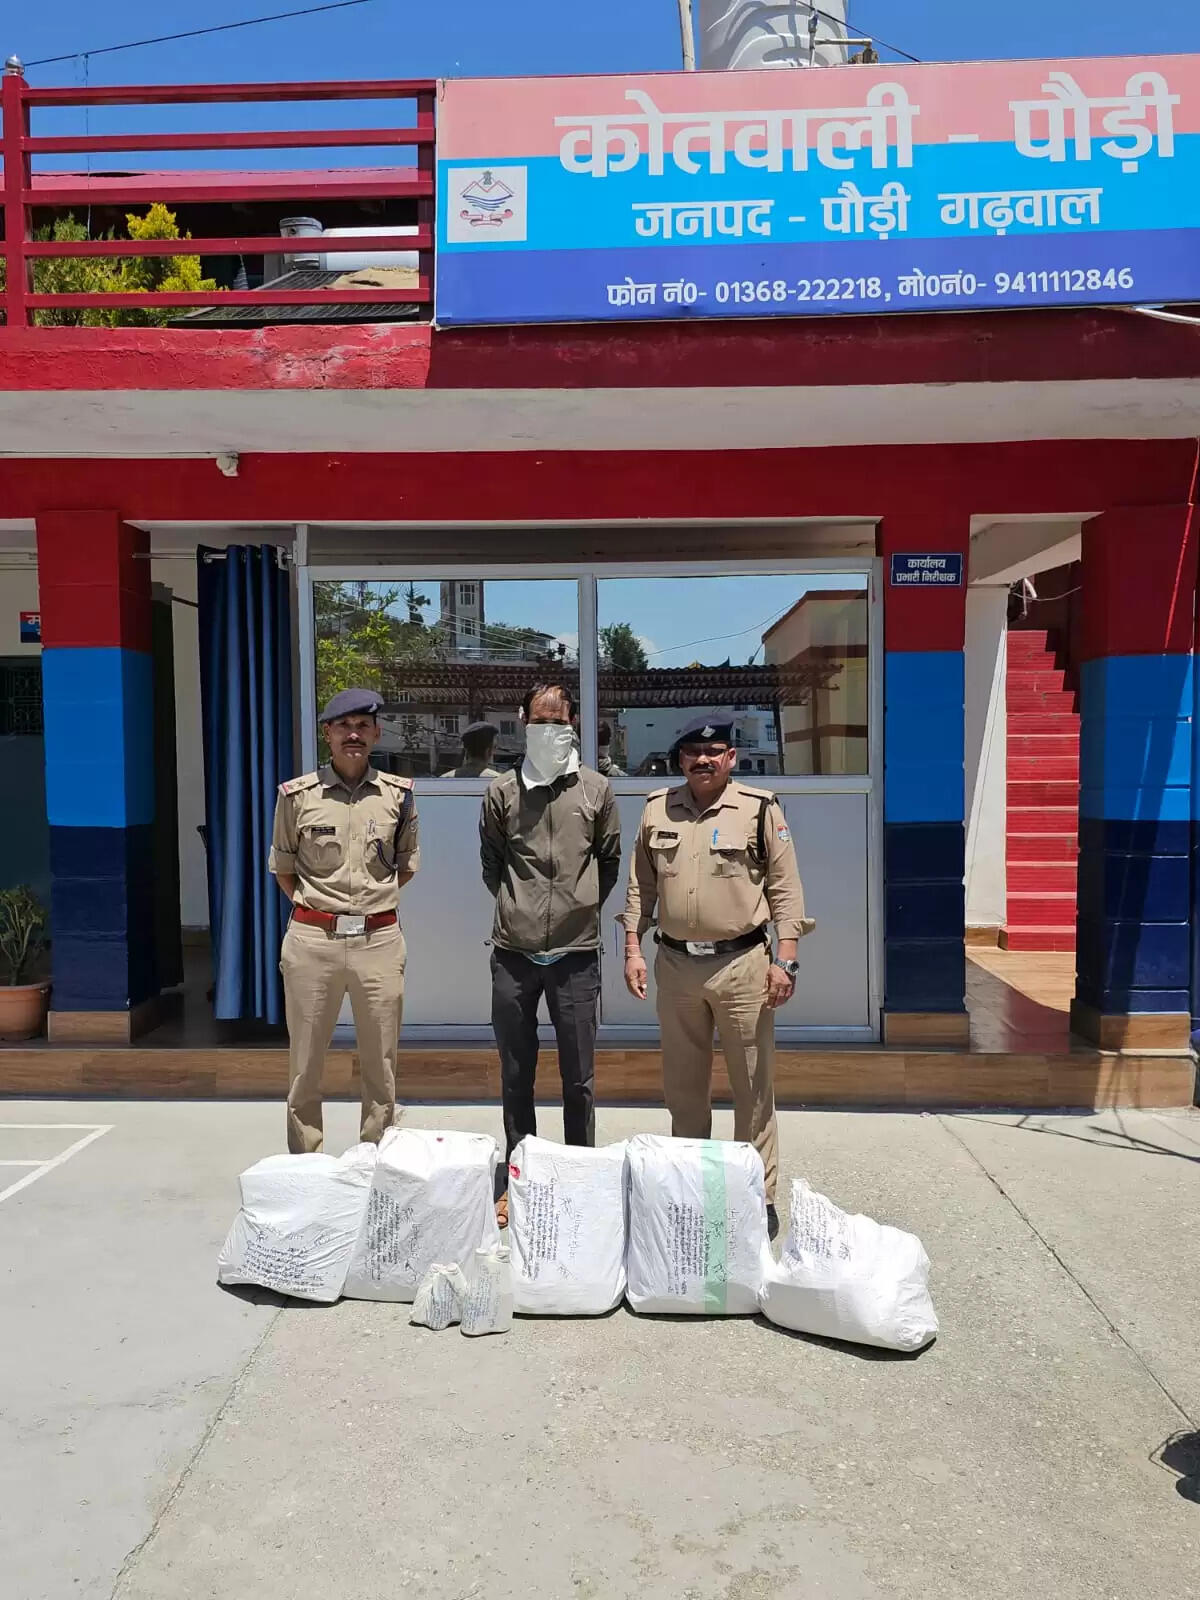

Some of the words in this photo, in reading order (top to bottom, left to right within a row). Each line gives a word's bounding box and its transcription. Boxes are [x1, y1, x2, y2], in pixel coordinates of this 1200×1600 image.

[554, 82, 921, 178] कोतवाली
[1008, 71, 1181, 174] पौड़ी
[631, 199, 775, 239] जनपद
[820, 181, 911, 241] पौड़ी
[937, 187, 1104, 236] गढ़वाल
[607, 277, 656, 307] फोन
[994, 267, 1134, 295] 9411112846
[907, 556, 946, 569] कार्यालय
